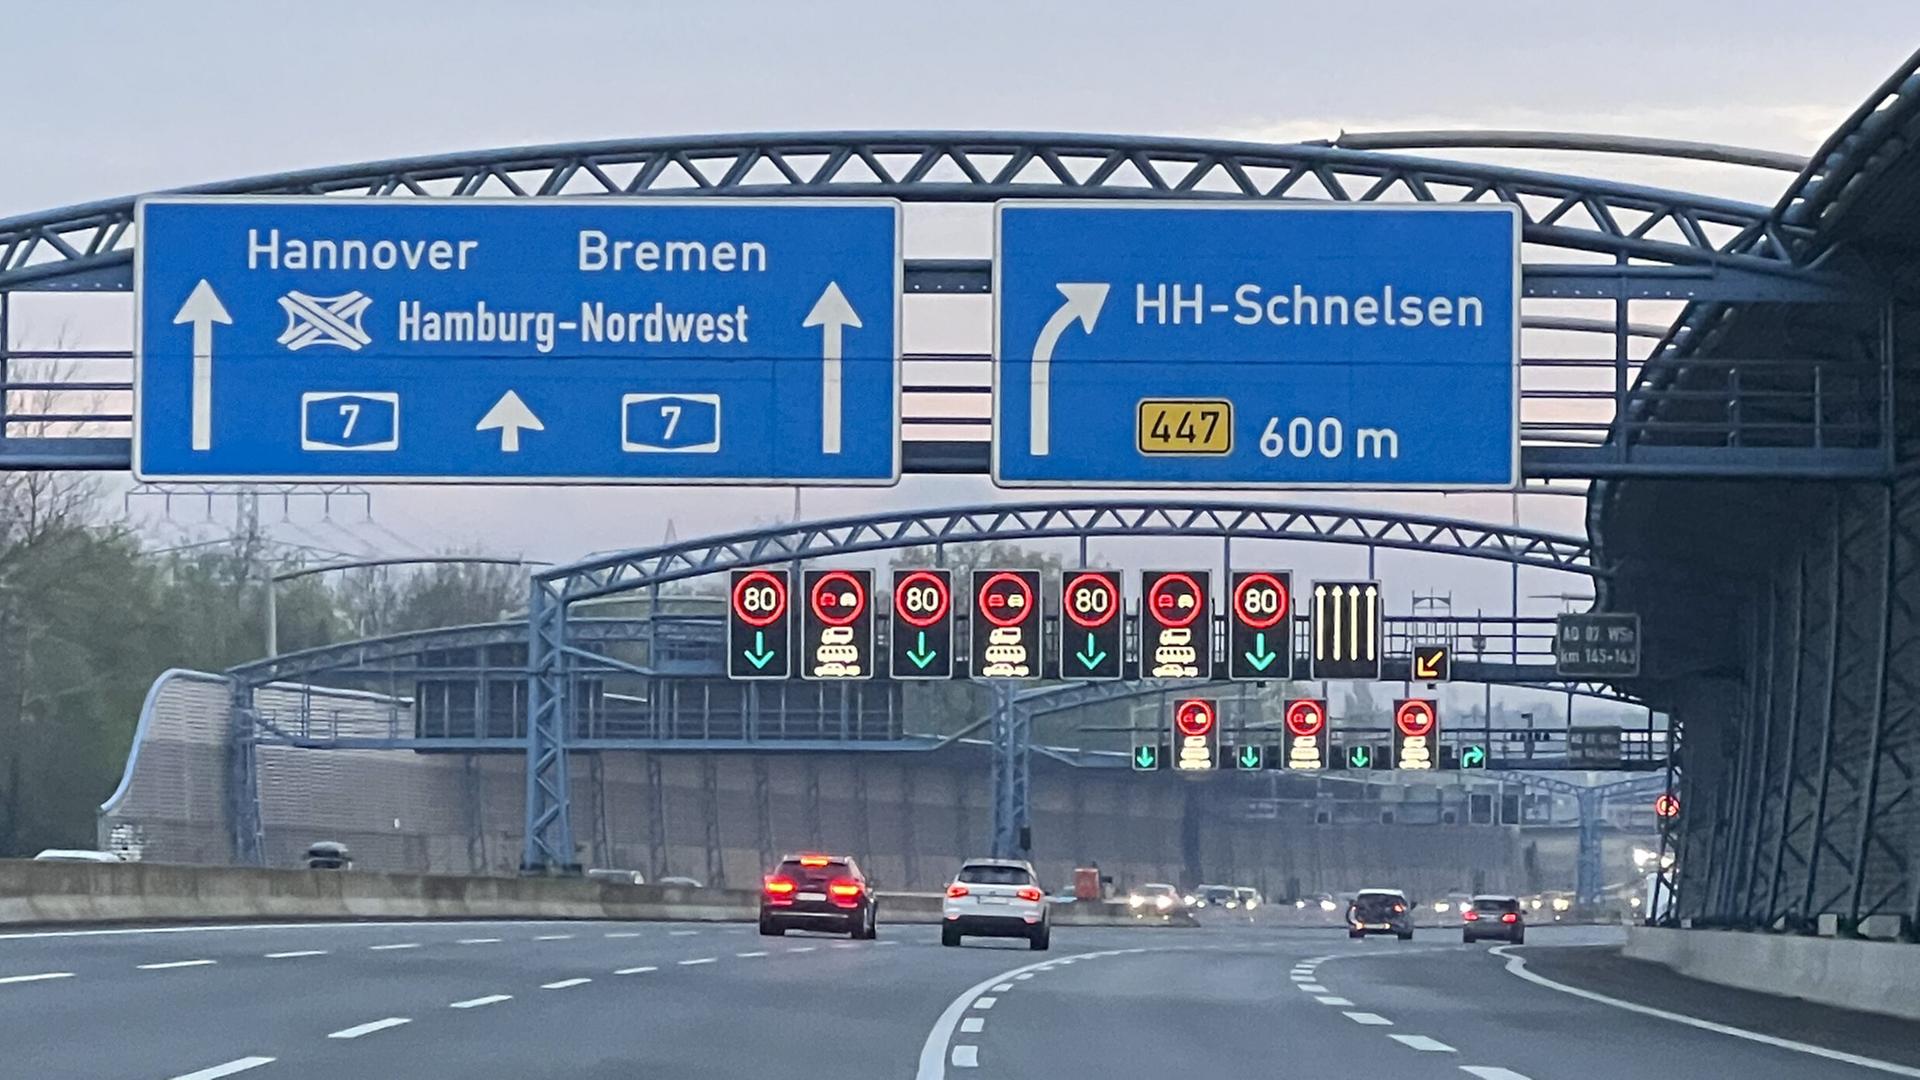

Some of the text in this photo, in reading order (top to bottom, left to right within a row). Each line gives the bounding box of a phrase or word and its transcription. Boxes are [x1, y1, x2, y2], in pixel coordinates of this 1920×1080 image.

[248, 229, 479, 271] Hannover
[578, 230, 767, 272] Bremen
[1136, 283, 1483, 327] HH-Schnelsen
[398, 301, 749, 353] Hamburg-Nordwest
[339, 404, 361, 439] 7
[660, 405, 682, 440] 7
[1149, 411, 1221, 444] 447
[1259, 416, 1399, 459] 600 m
[743, 586, 776, 612] 80
[906, 586, 939, 612] 80
[1075, 588, 1108, 613] 80
[1244, 588, 1278, 614] 80
[1561, 648, 1580, 663] km
